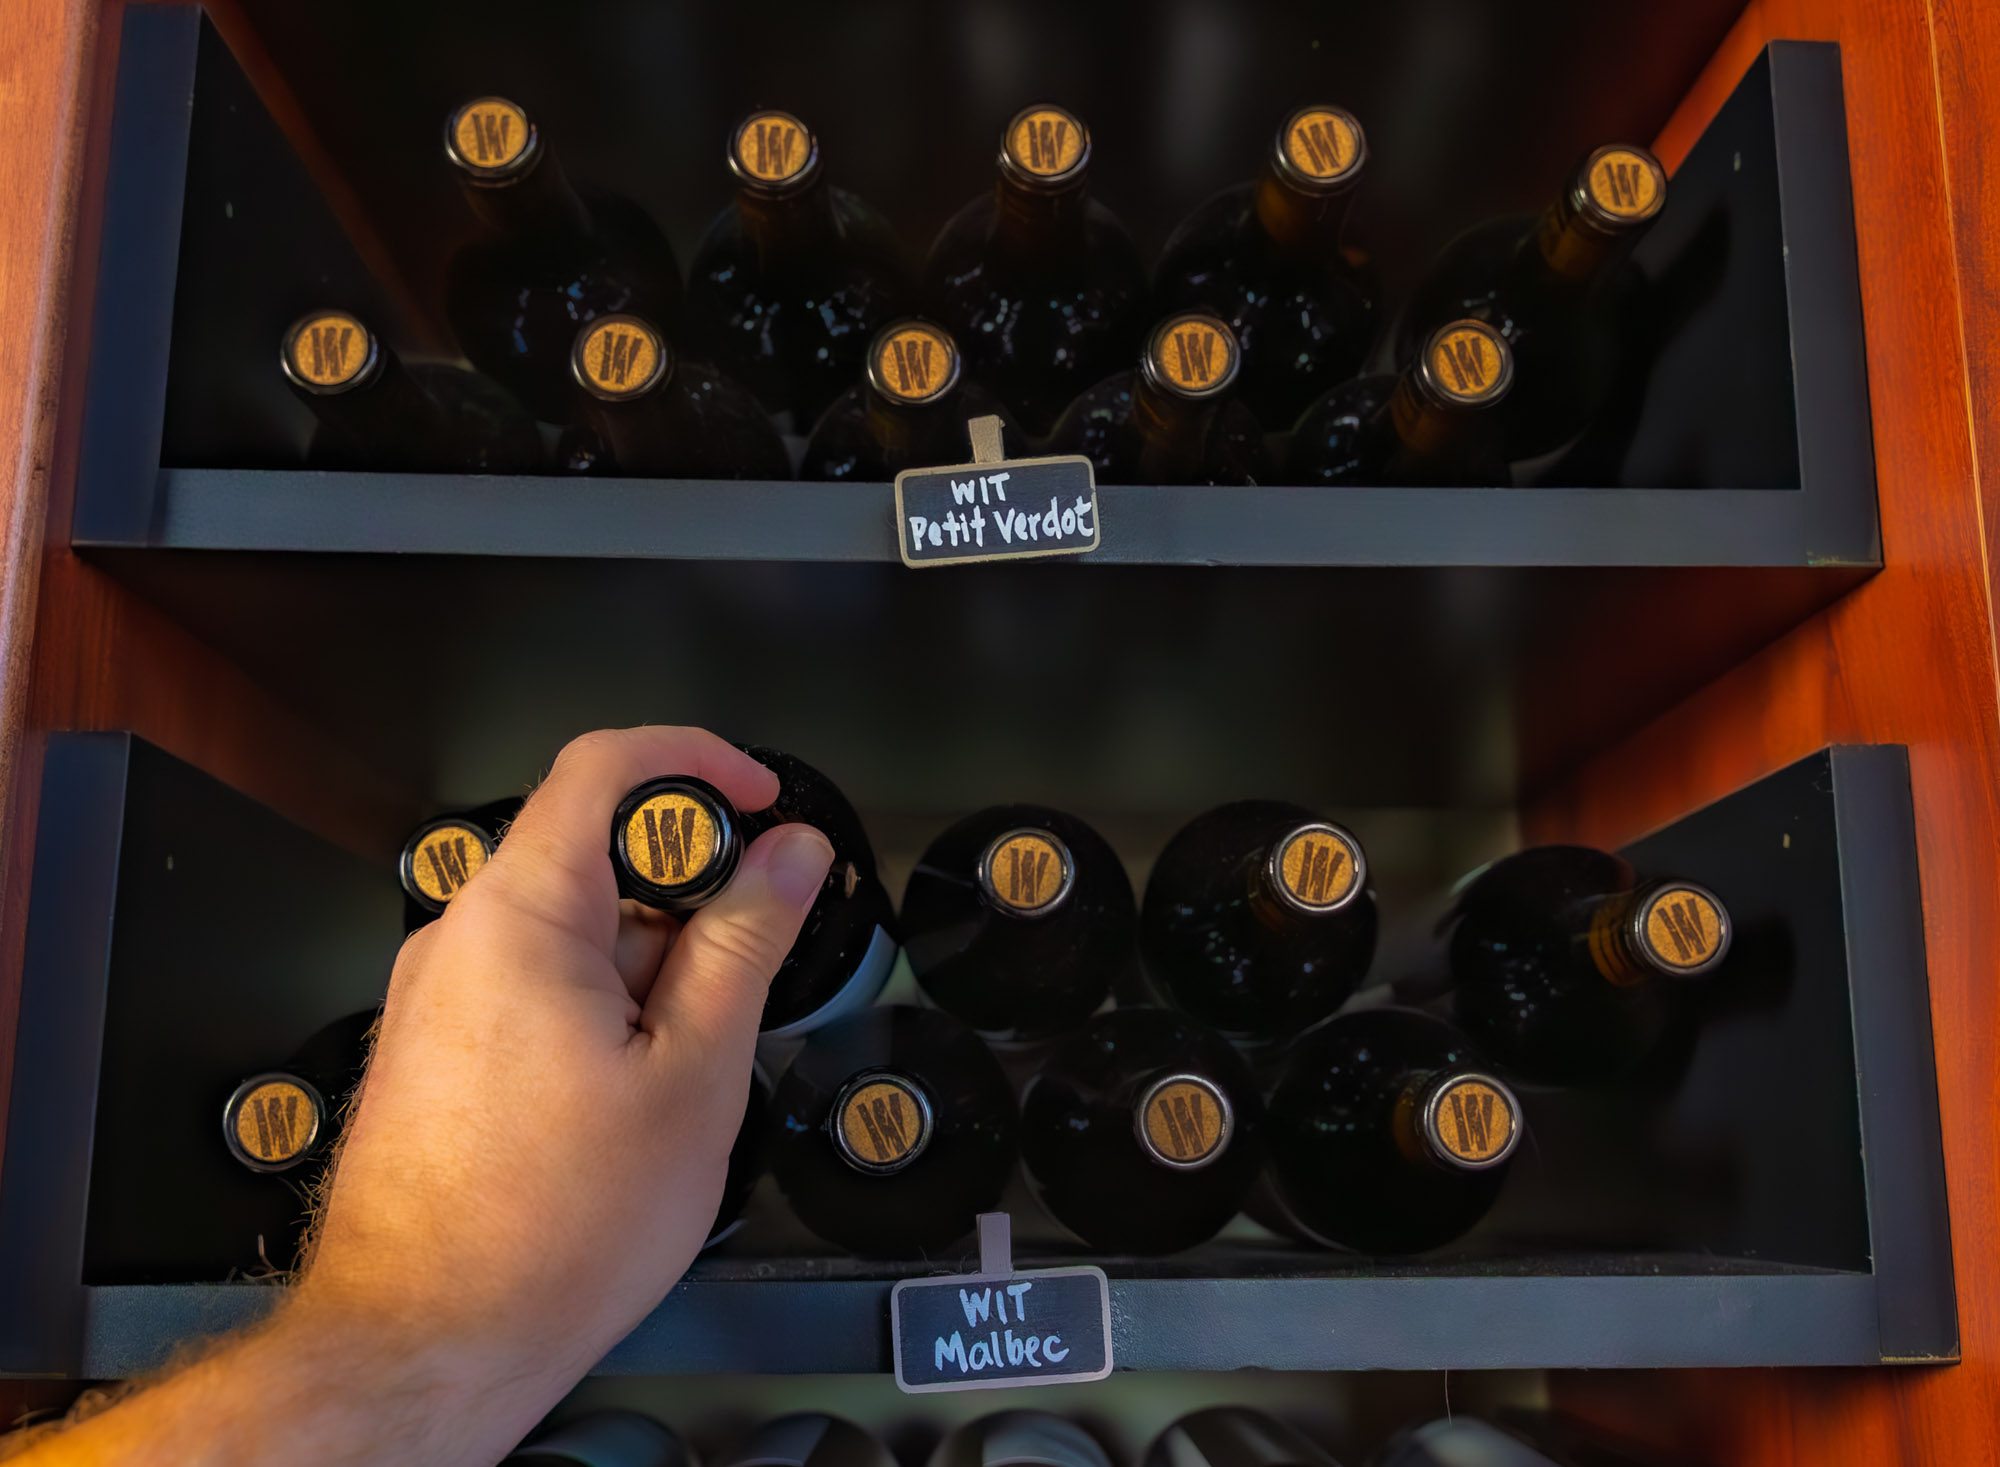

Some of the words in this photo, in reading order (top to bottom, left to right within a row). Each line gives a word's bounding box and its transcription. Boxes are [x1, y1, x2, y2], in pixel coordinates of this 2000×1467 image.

[472, 114, 510, 160] W
[756, 124, 796, 175] W
[1028, 121, 1066, 169] W
[1297, 120, 1340, 173] W
[1604, 162, 1640, 207] W
[311, 326, 353, 376] W
[600, 331, 643, 384] W
[892, 340, 931, 391] W
[1174, 332, 1214, 381] W
[1441, 337, 1485, 391] W
[951, 472, 1010, 505] WIT
[909, 505, 986, 551] Petit
[992, 496, 1094, 544] Verdot
[424, 837, 469, 895] W
[643, 808, 697, 879] W
[1009, 847, 1050, 903] W
[1295, 841, 1344, 901] W
[1656, 897, 1707, 958] W
[253, 1096, 298, 1158] W
[856, 1093, 907, 1161] W
[1159, 1093, 1206, 1157] W
[1450, 1093, 1494, 1152] W
[959, 1282, 1032, 1328] WIT
[935, 1329, 1070, 1374] Malbec
